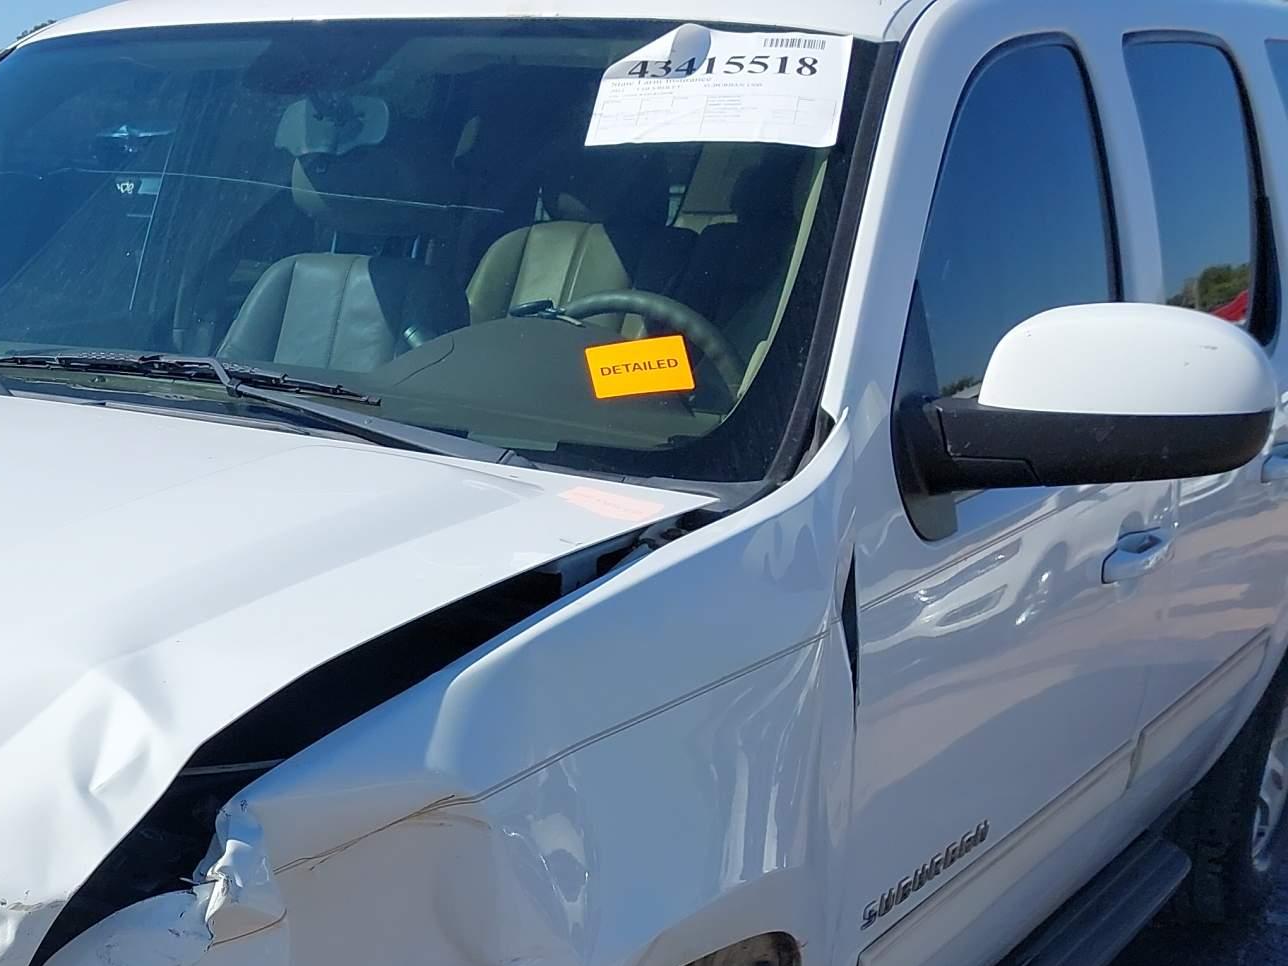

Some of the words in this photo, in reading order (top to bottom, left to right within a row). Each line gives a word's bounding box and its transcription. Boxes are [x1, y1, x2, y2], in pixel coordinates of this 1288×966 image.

[627, 54, 819, 79] 43415518
[599, 358, 679, 376] DETAILED
[860, 819, 990, 931] SUBURBAN
